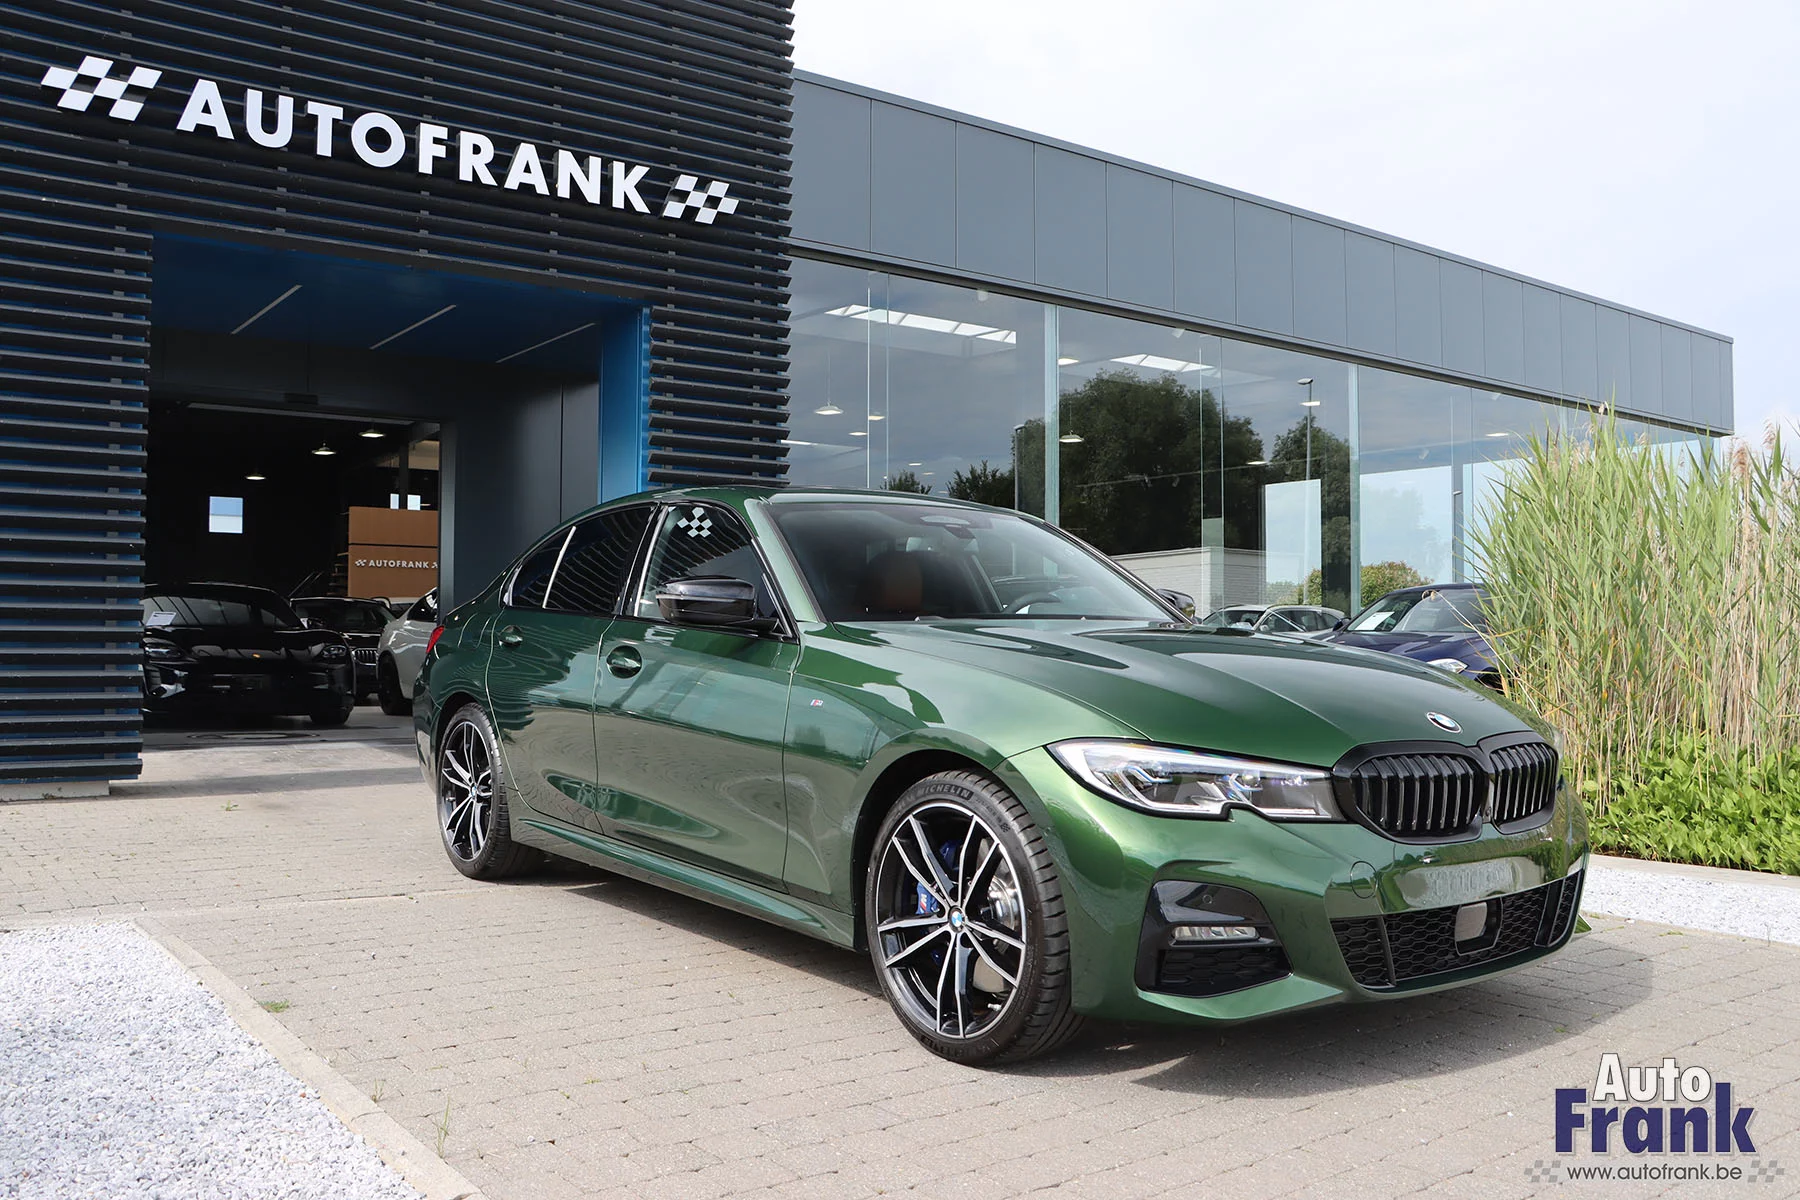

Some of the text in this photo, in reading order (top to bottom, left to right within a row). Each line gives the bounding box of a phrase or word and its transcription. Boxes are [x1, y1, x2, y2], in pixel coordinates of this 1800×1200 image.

[175, 79, 651, 213] AUTOFRANK
[368, 559, 429, 569] AUTOFRANK
[916, 784, 970, 799] MICHELIN
